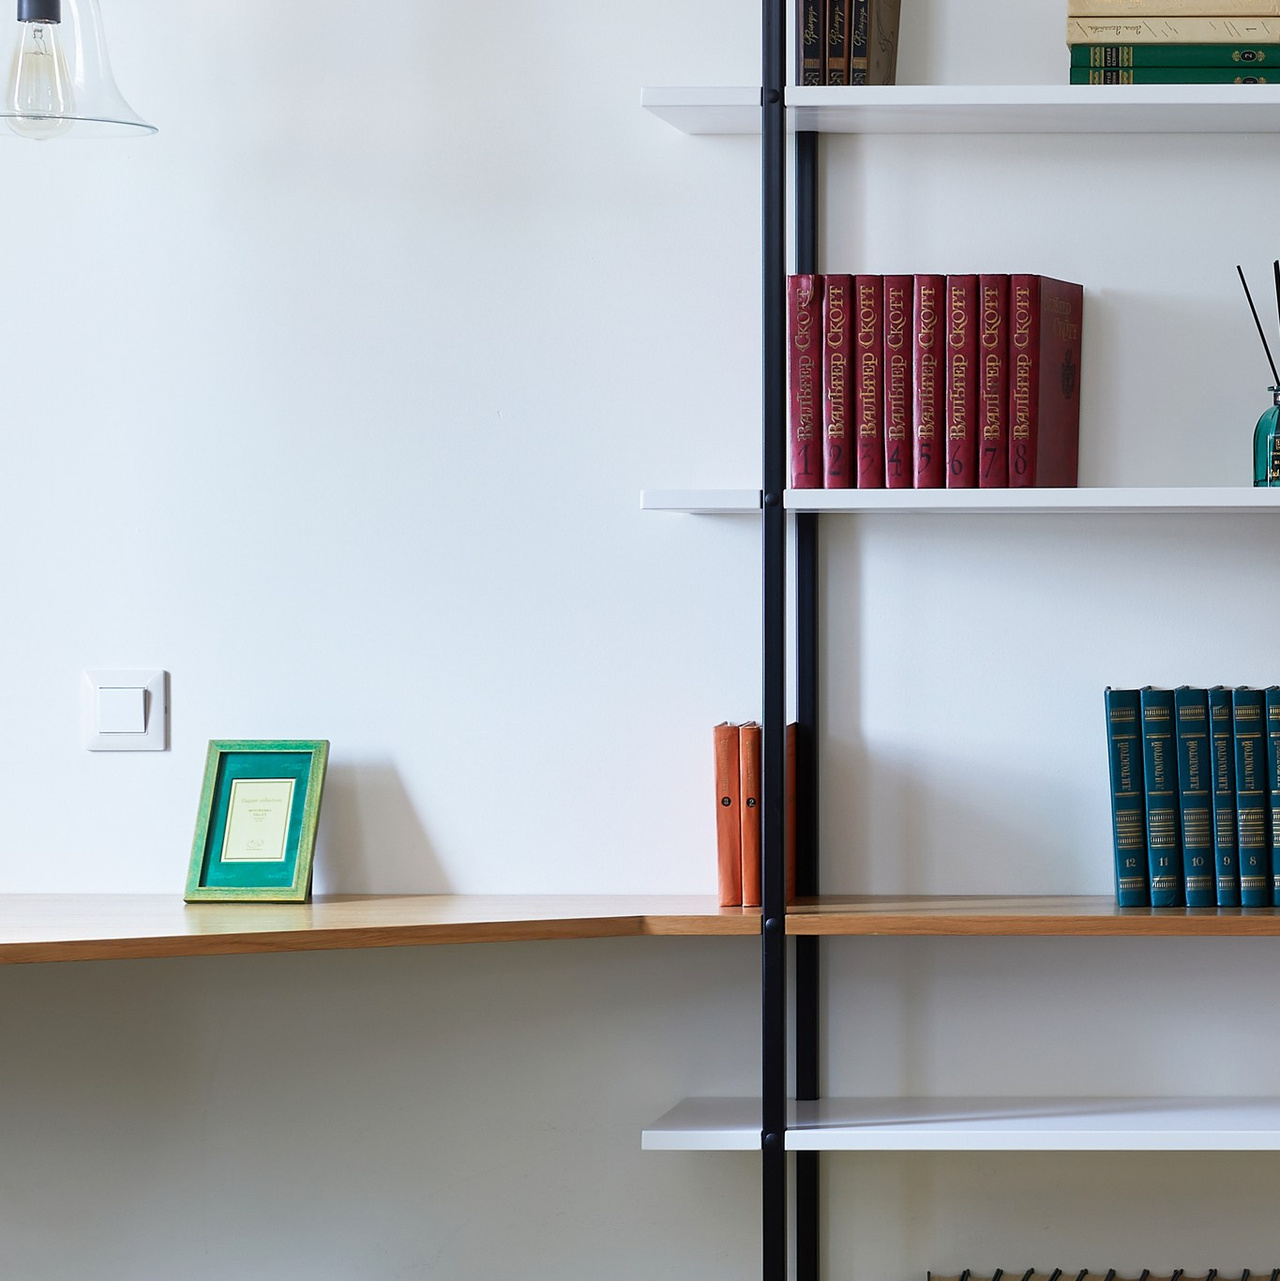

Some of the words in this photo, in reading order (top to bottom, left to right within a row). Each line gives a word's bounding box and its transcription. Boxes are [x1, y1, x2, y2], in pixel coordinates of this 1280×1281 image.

[798, 444, 812, 477] 1
[829, 444, 842, 476] 2
[861, 444, 875, 475] 3
[888, 444, 902, 476] 4
[917, 444, 931, 475] 5
[951, 445, 964, 476] 6
[984, 446, 998, 478] 7
[1014, 444, 1027, 475] 8
[1125, 858, 1137, 868] 12
[1159, 858, 1168, 867] 11
[1192, 857, 1203, 866] 10
[1223, 857, 1230, 866] 9
[1250, 857, 1256, 866] 8
